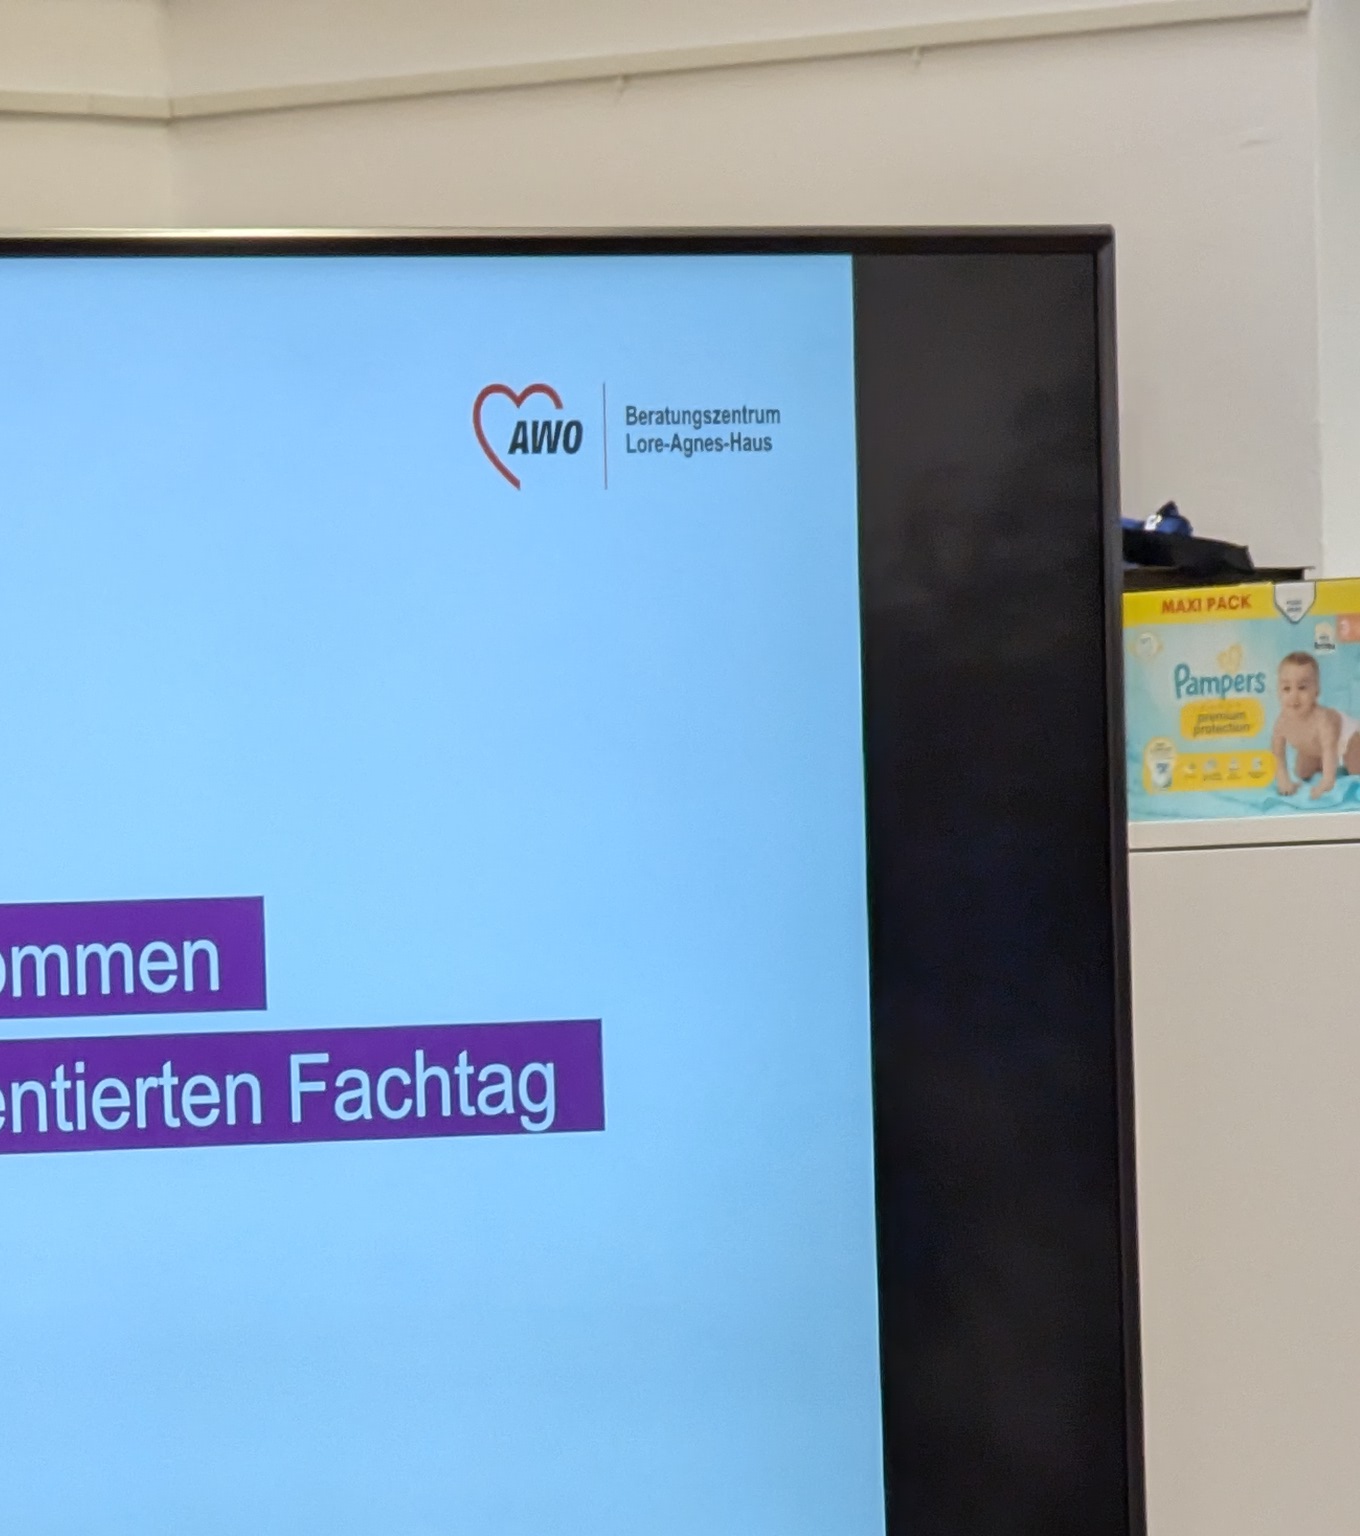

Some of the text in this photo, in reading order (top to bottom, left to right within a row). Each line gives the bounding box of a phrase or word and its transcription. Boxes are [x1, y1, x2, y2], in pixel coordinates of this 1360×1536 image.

[625, 404, 782, 430] Beratungszentrum
[508, 419, 584, 455] AWO
[625, 431, 774, 458] Lore-Agnes-Haus
[1161, 593, 1252, 615] MAXI PACK
[1173, 662, 1267, 701] Pampers
[289, 1048, 556, 1133] Fachtag
